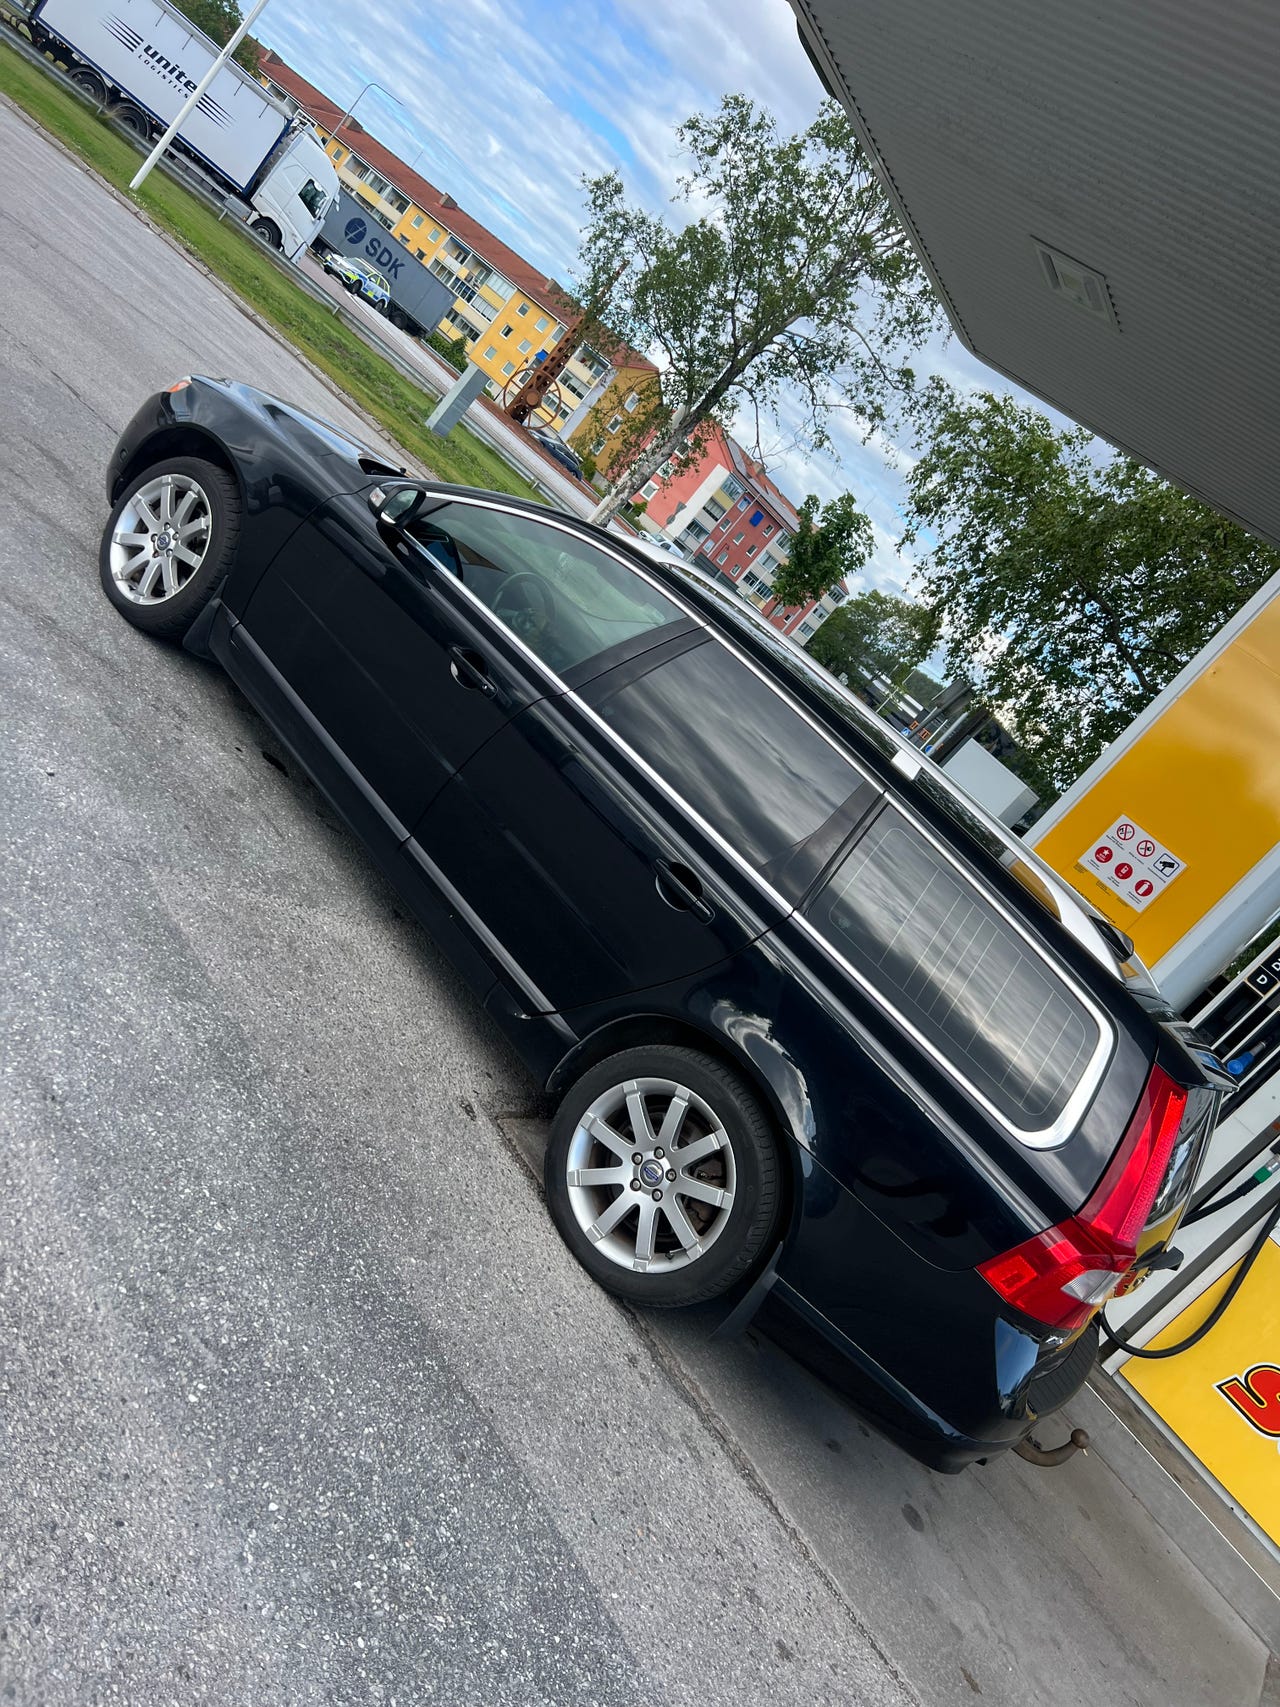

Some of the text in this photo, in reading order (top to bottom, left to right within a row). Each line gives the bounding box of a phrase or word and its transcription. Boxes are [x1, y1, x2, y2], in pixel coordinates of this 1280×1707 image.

[138, 54, 188, 99] LOGISTICS
[143, 44, 198, 93] unite
[365, 237, 405, 280] SDK
[1256, 974, 1268, 985] D
